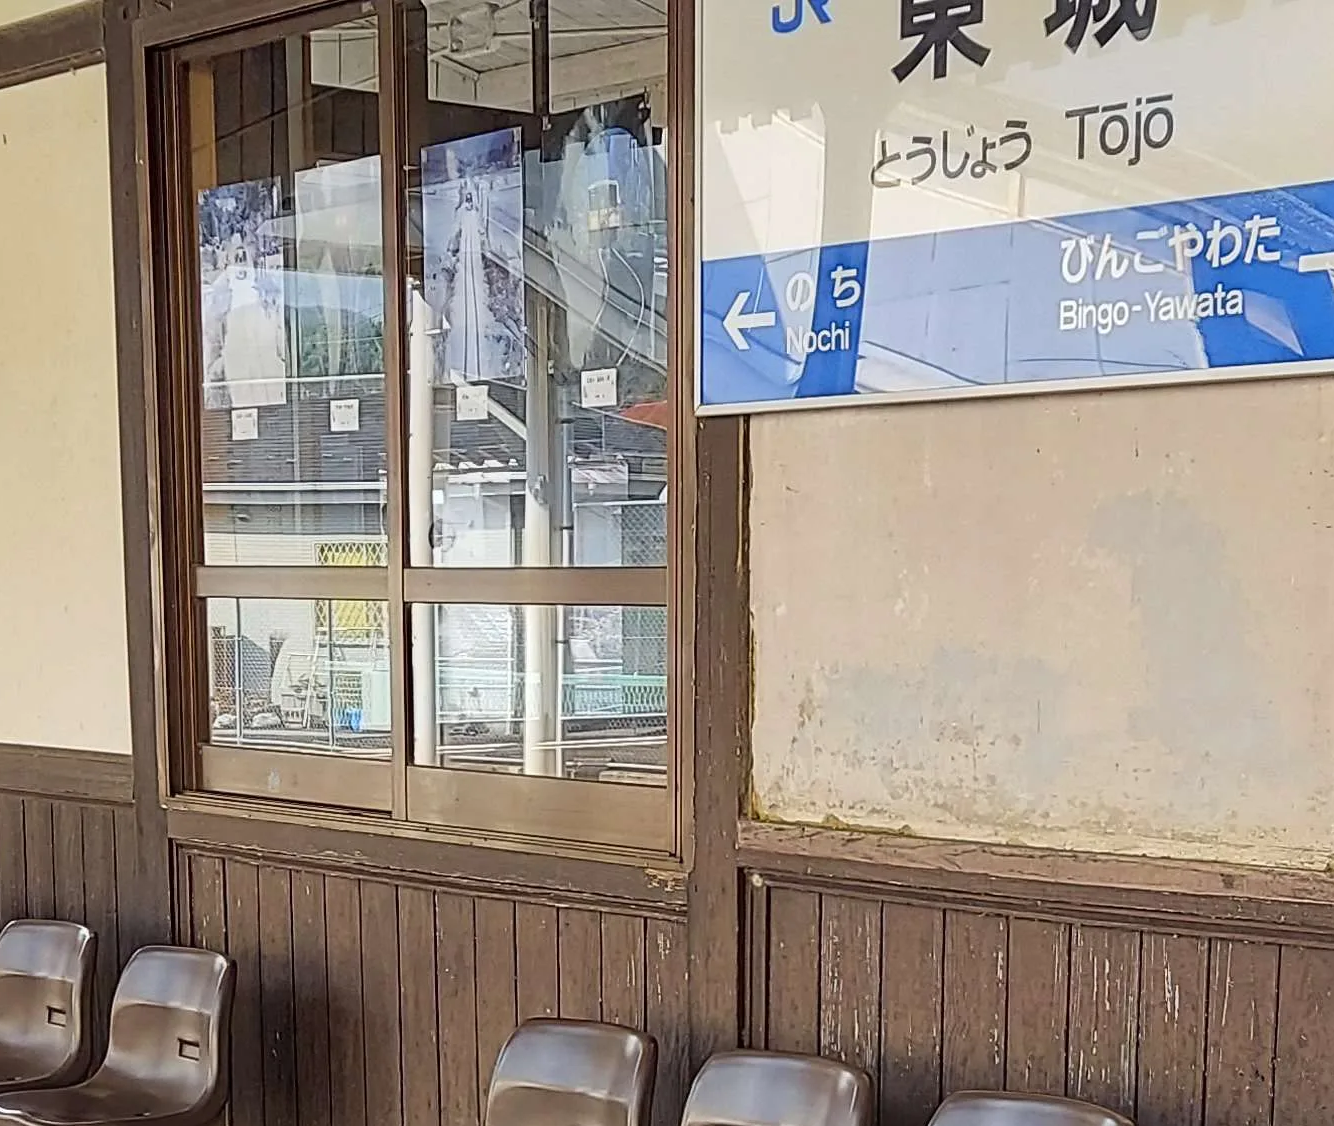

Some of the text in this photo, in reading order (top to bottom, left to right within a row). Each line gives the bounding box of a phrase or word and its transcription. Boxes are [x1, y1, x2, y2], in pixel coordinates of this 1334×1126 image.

[871, 93, 1174, 188] とうじょう Tōjō
[1060, 214, 1282, 284] びんごやわた
[785, 264, 862, 312] のち
[1059, 283, 1244, 335] Bingo-Yawata
[785, 320, 852, 355] Nochi
